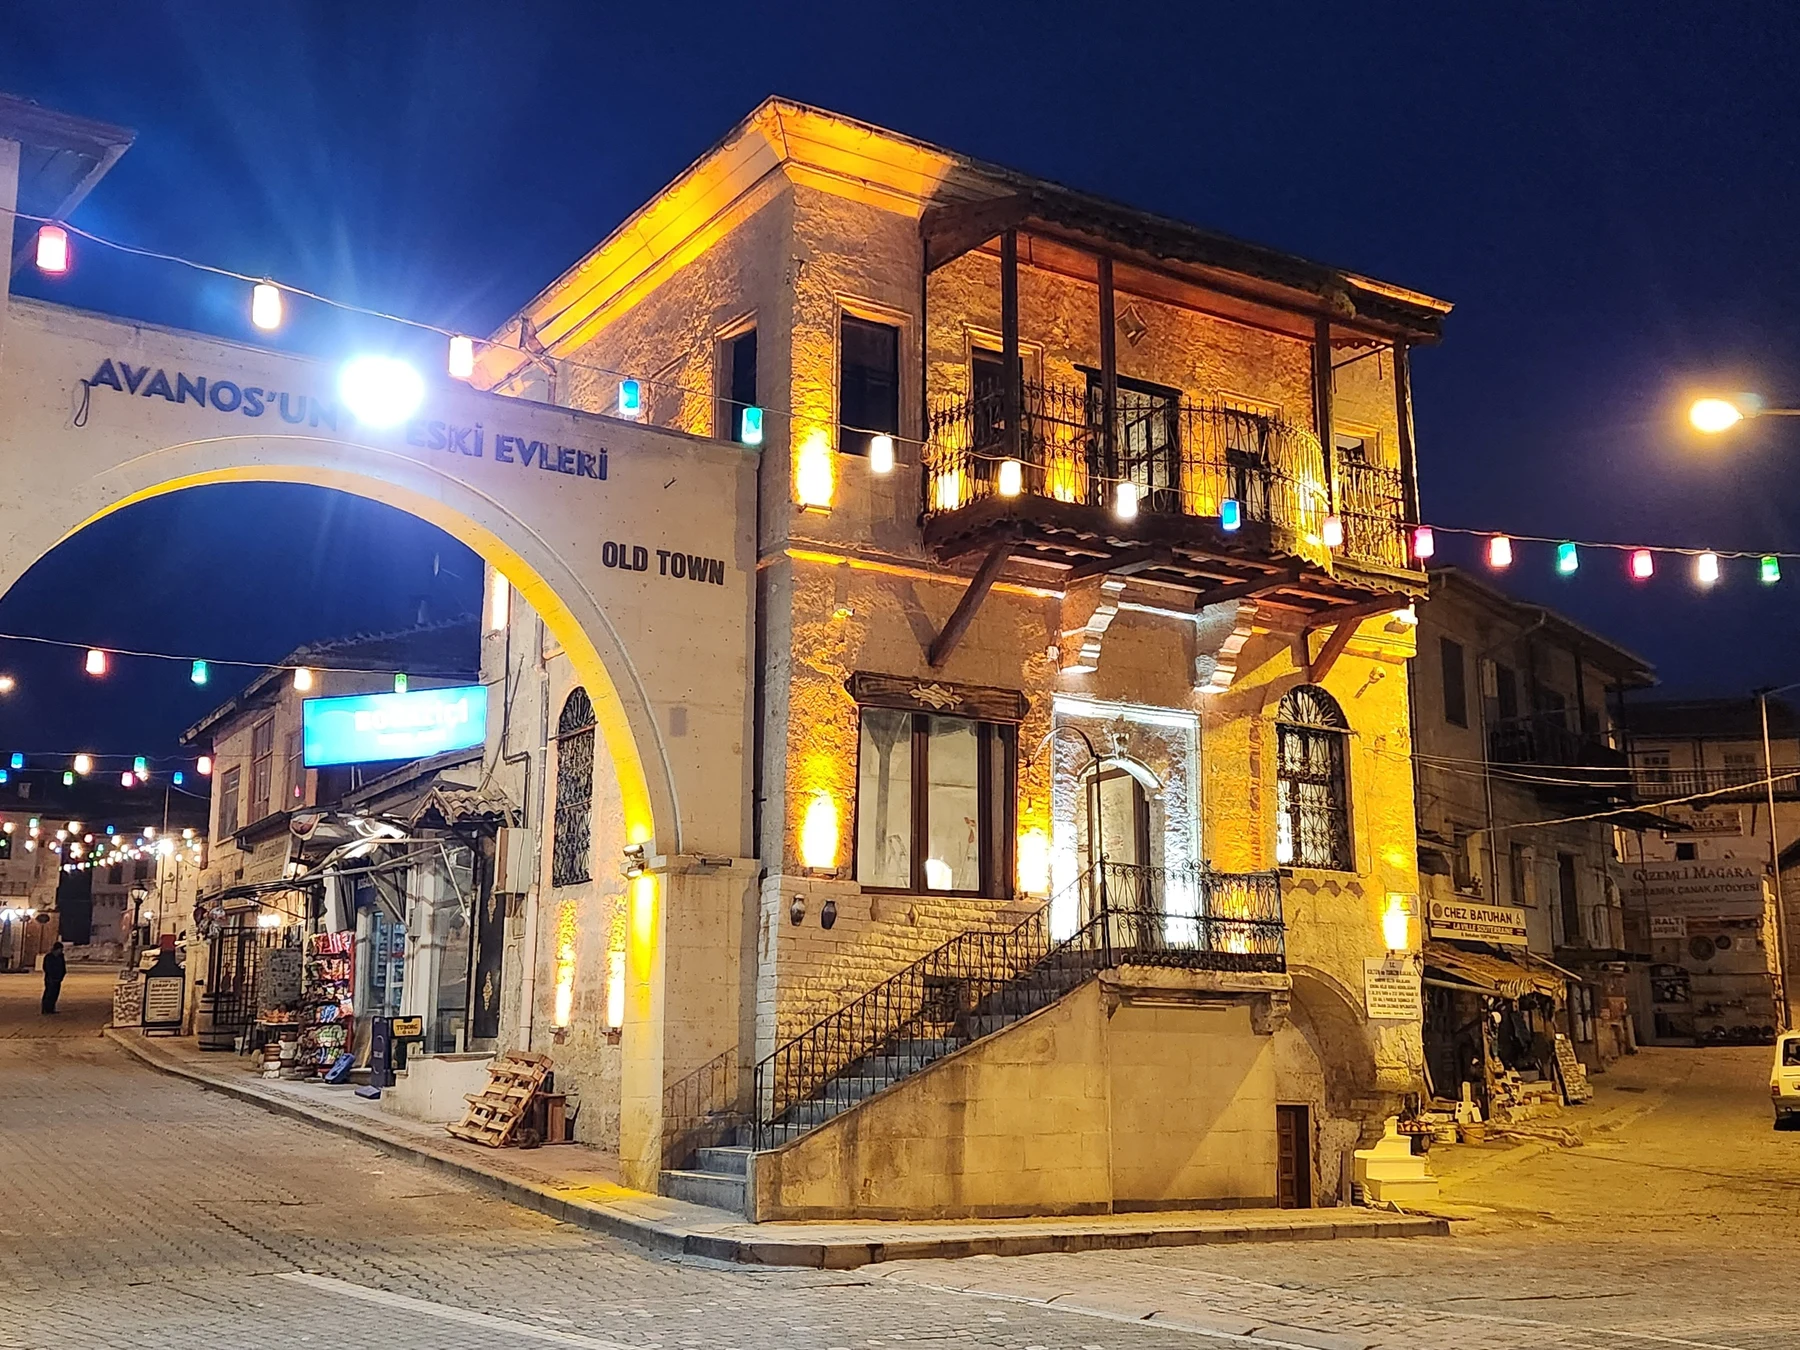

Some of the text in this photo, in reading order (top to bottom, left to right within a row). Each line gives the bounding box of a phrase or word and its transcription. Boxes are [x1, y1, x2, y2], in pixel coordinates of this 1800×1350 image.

[90, 358, 608, 481] AVANOS'UN ESKİ EVLERİ
[602, 541, 724, 585] OLD TOWN
[1678, 884, 1711, 896] ÇANAK
[1713, 881, 1760, 893] ATÖLYESİ
[1443, 906, 1513, 925] CHEZ BATUHAN
